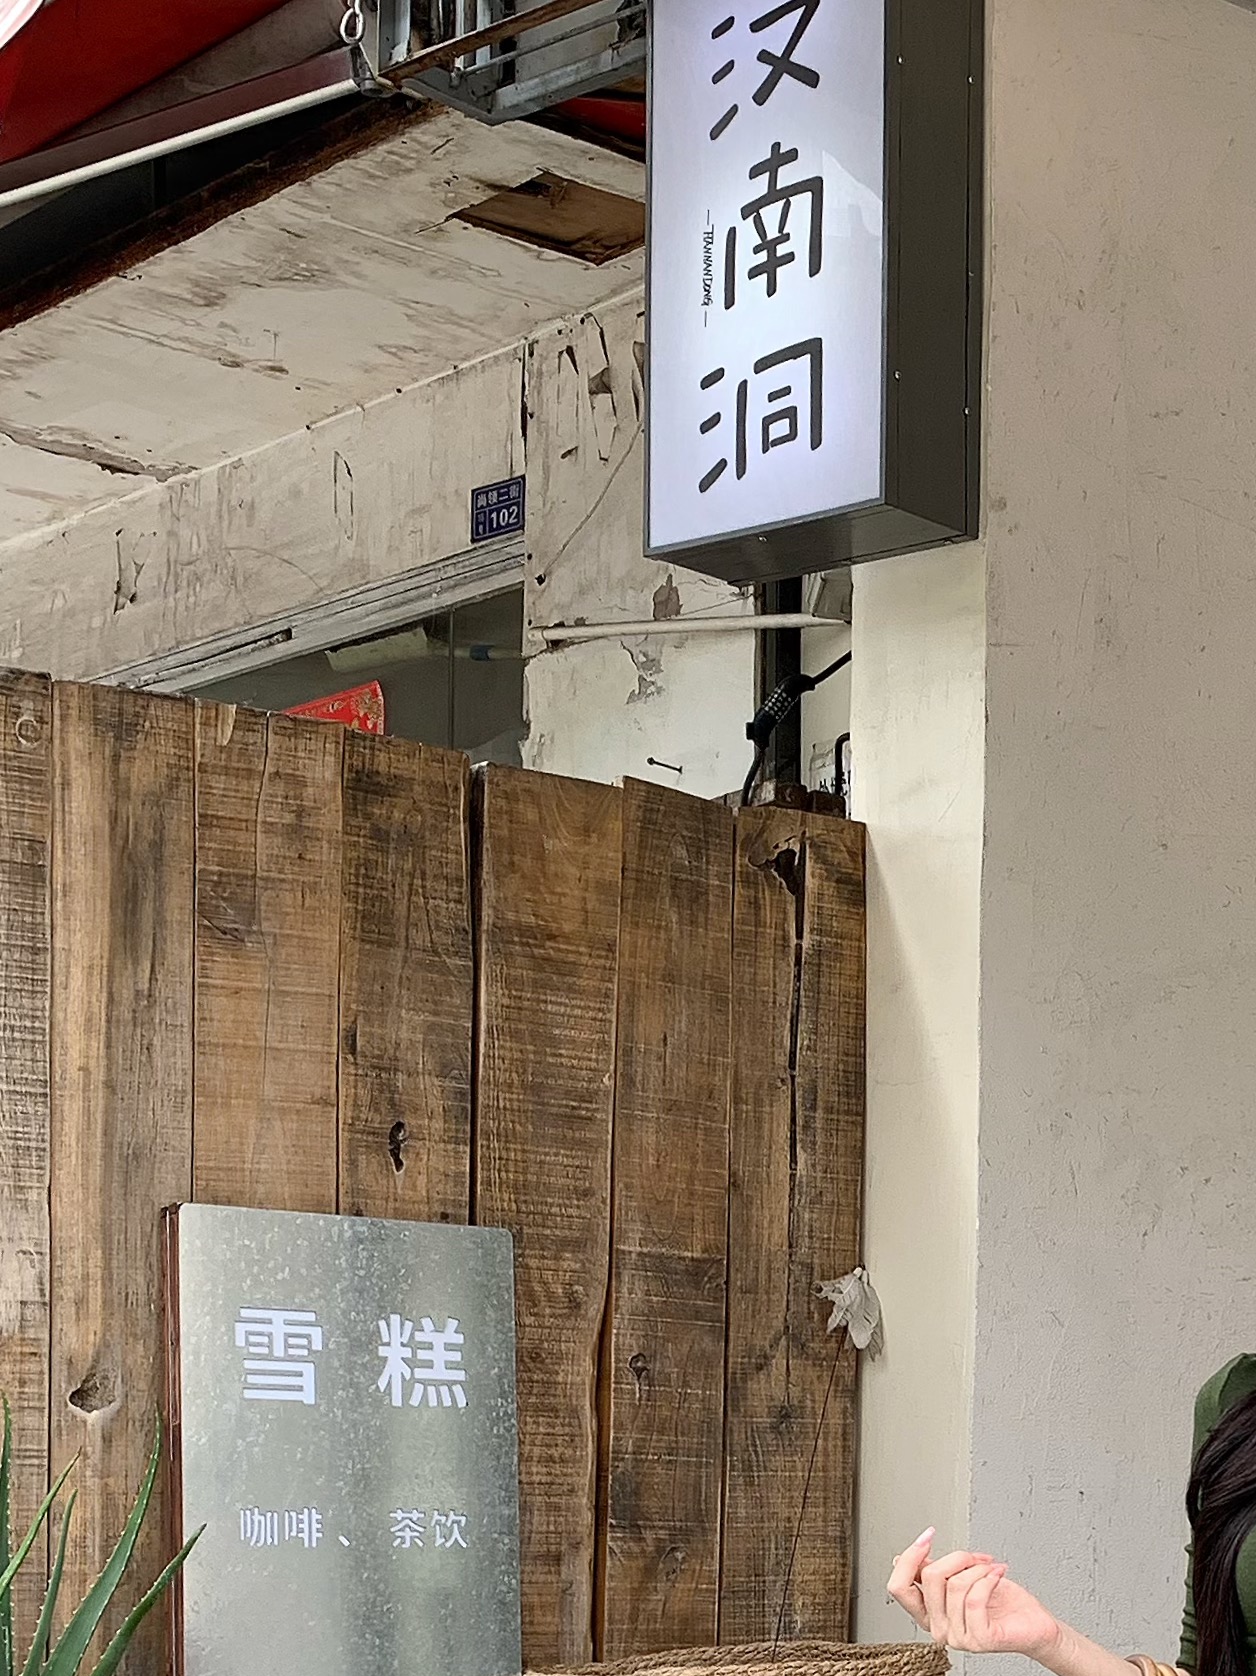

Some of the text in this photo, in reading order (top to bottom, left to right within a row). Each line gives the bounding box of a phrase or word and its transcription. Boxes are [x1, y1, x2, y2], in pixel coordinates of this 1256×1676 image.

[699, 0, 823, 493] 汉南洞
[490, 505, 518, 528] 102
[235, 1307, 467, 1408] 雪糕
[239, 1507, 467, 1548] 咖啡、茶饮
